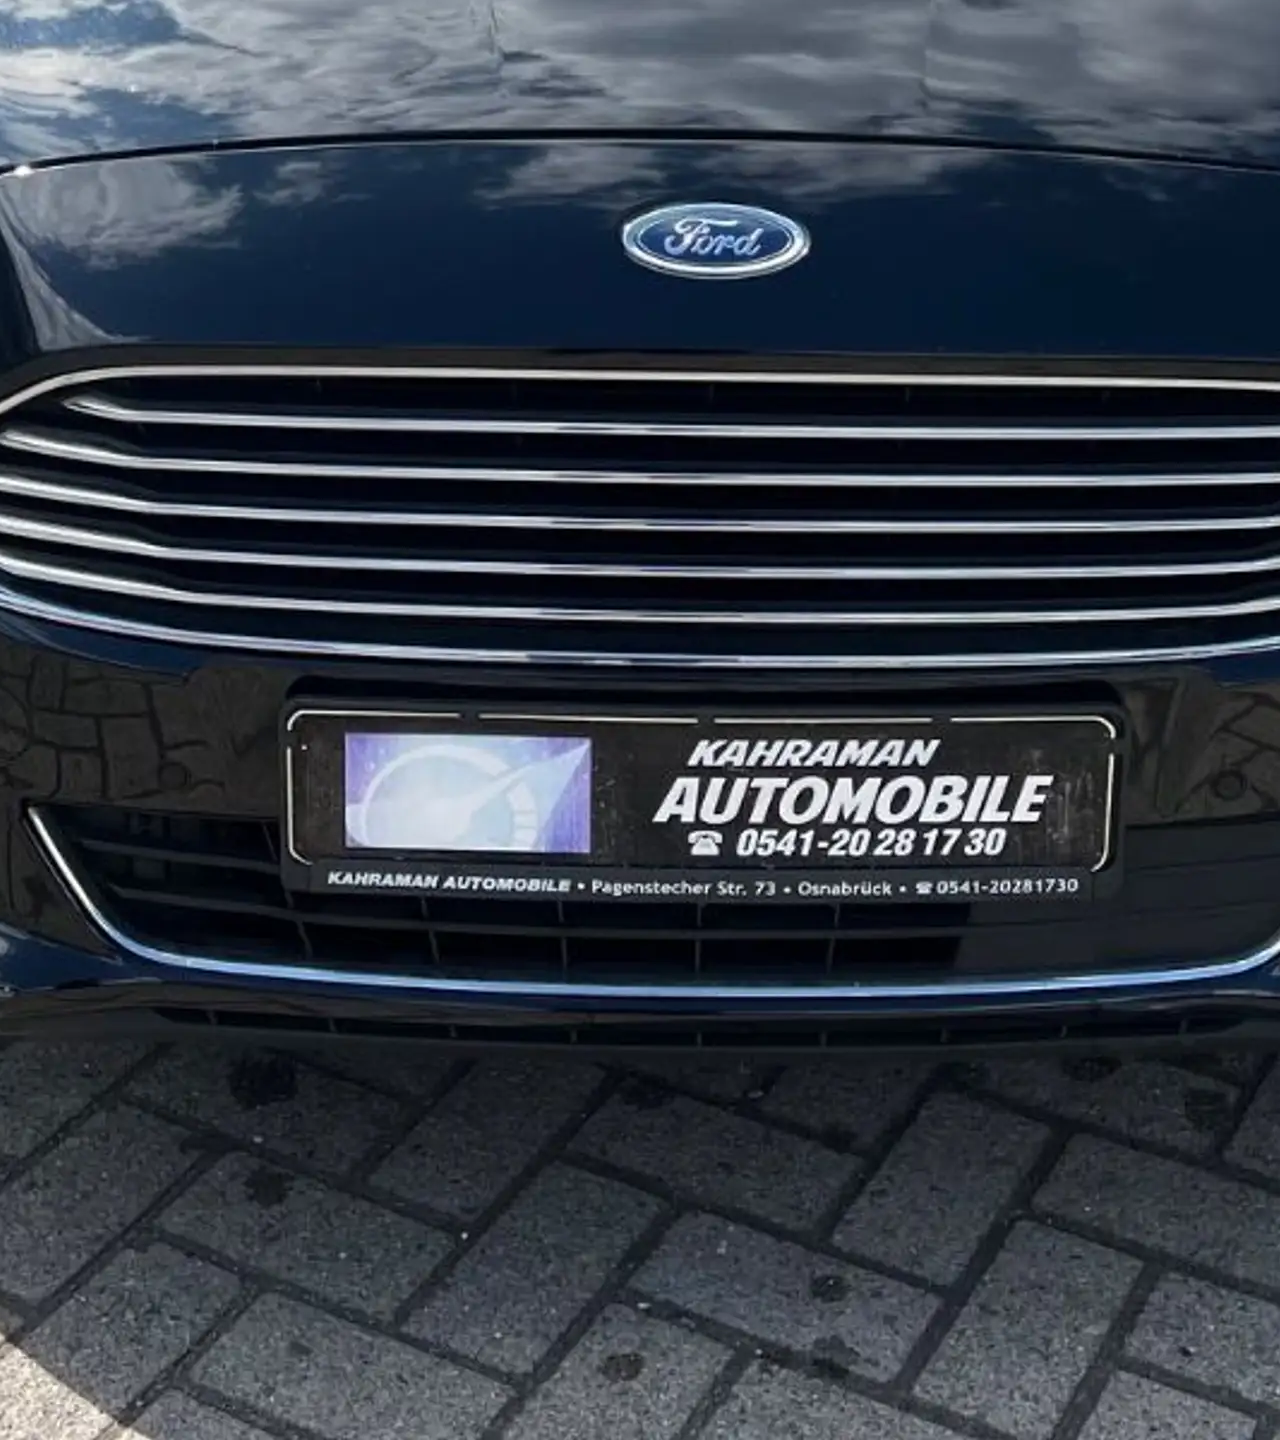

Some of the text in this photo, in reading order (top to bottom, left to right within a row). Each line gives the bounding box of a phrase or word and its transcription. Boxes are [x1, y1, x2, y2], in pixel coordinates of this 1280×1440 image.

[664, 218, 764, 256] Ford
[687, 739, 941, 767] KAHRAMAN
[652, 774, 1054, 825] AUTOMOBILE
[735, 828, 1007, 857] 0541-20 28 17 30
[327, 871, 1079, 897] KAHRAMAN AUTOMOBILE Pagenstecher Str. 73 Osnabrück 0541-20281730
